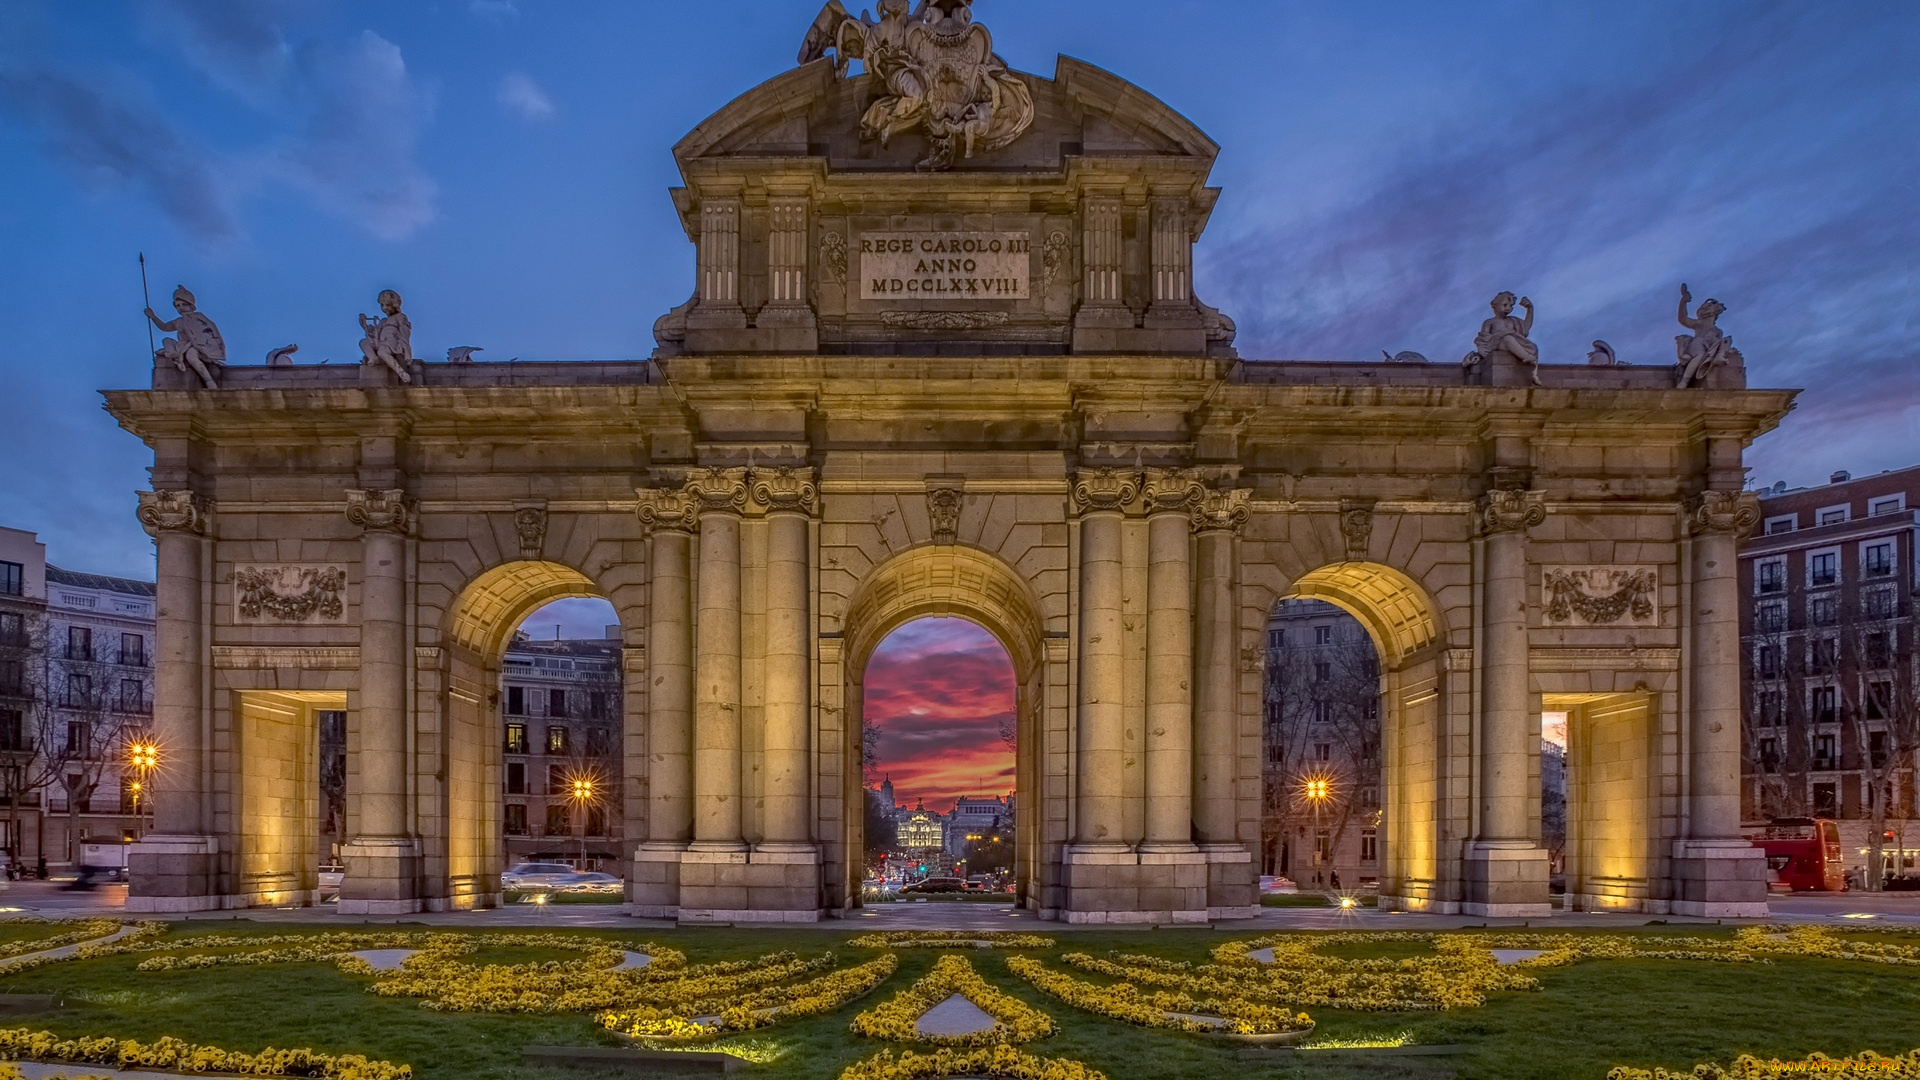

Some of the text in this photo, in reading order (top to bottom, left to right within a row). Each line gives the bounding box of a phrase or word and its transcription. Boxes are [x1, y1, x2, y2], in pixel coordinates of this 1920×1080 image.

[861, 239, 1030, 253] REGE CAROLO III
[914, 258, 977, 273] ANNO
[872, 278, 1018, 292] MDCCLXXVIII
